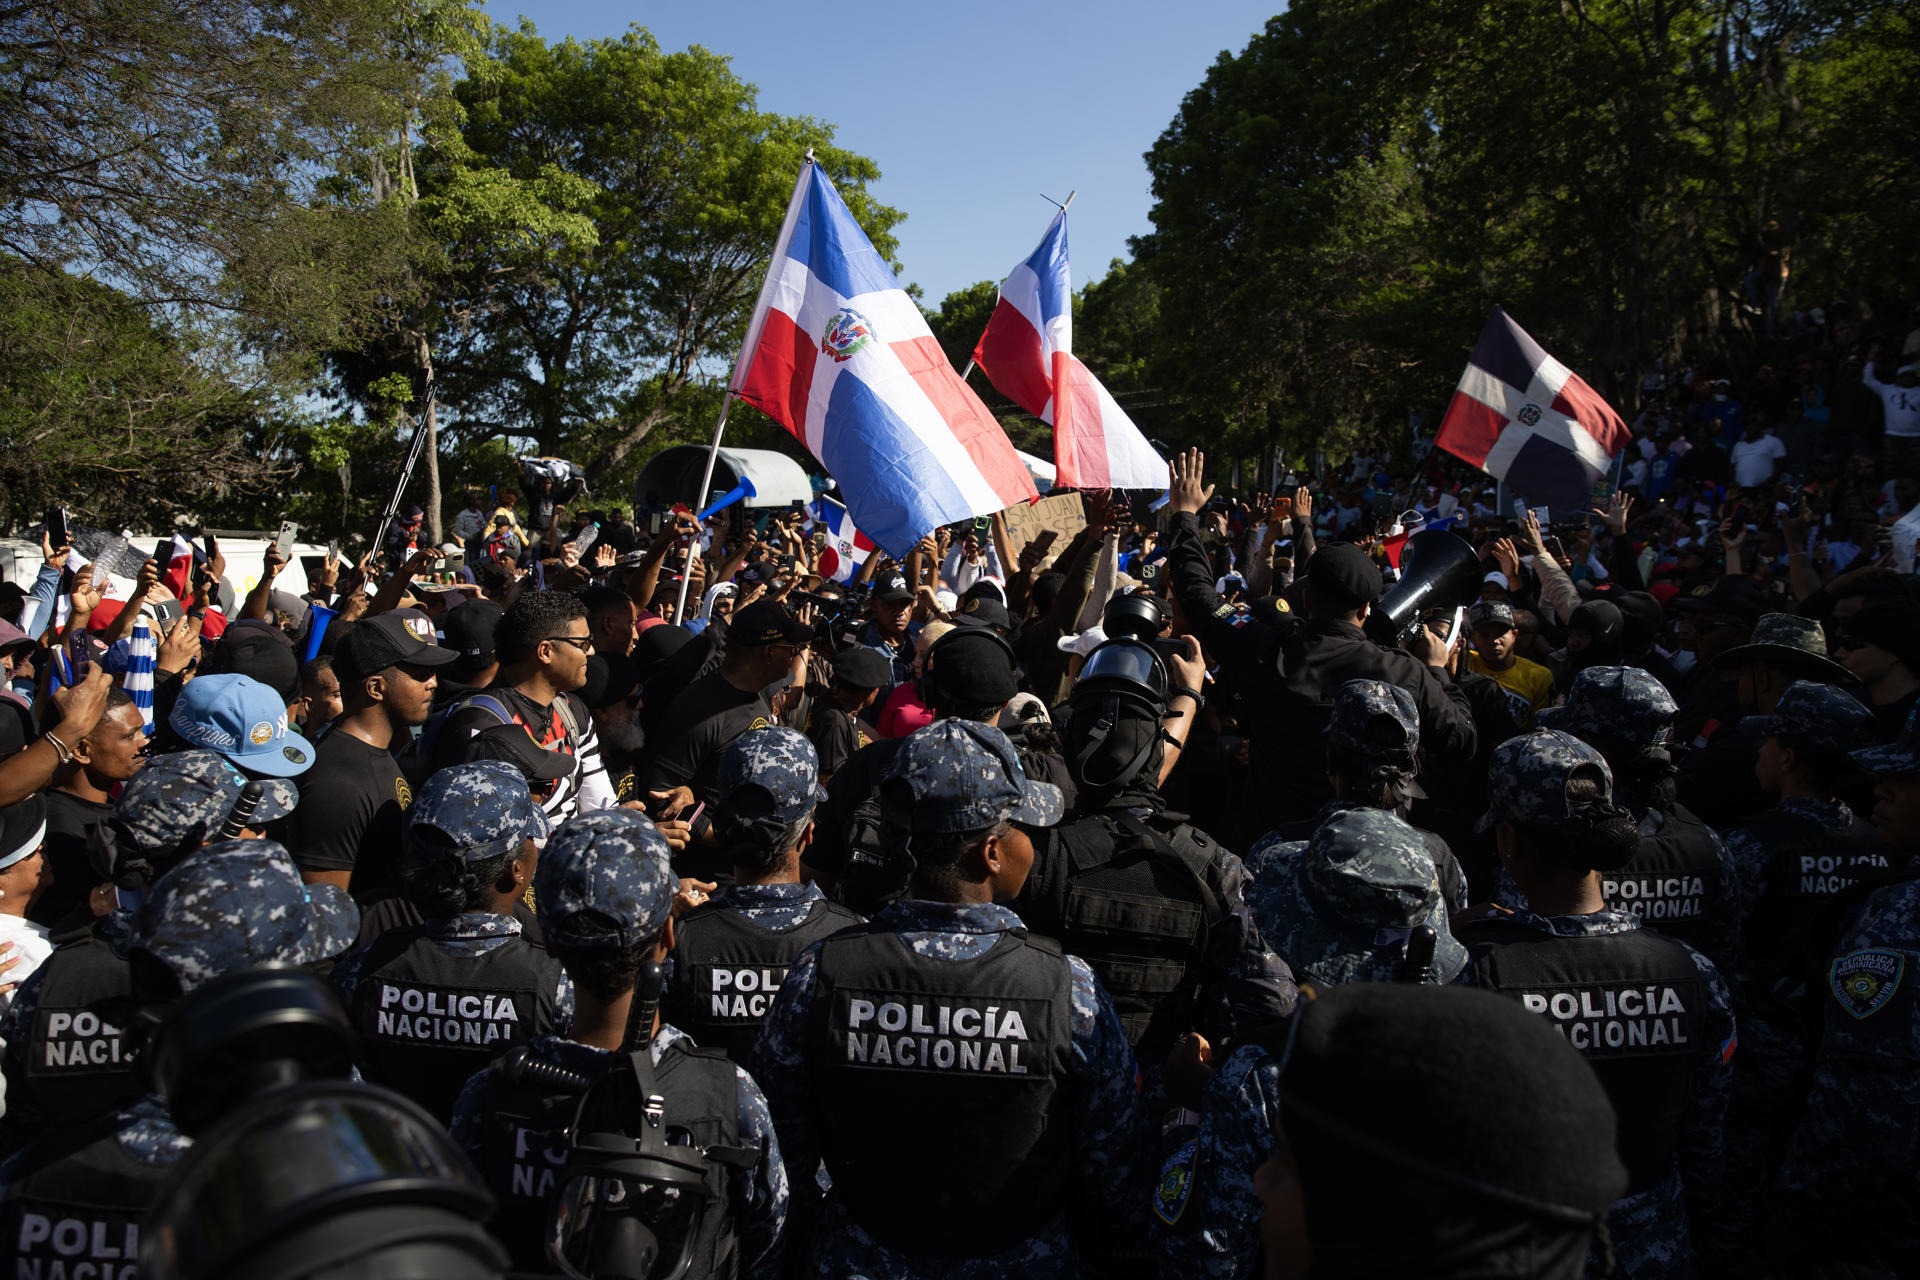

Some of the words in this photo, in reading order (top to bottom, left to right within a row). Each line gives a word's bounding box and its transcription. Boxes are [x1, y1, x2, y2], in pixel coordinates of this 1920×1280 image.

[1007, 503, 1040, 526] SAN
[1041, 496, 1080, 520] JUAN
[1052, 515, 1076, 542] SE
[1602, 876, 1704, 900] POLICÍA
[379, 984, 519, 1022] POLICÍA
[849, 998, 1029, 1041] POLICÍA
[1523, 985, 1686, 1020] POLICÍA
[847, 1031, 1028, 1074] NACIONAL
[17, 1212, 139, 1260] POLI
